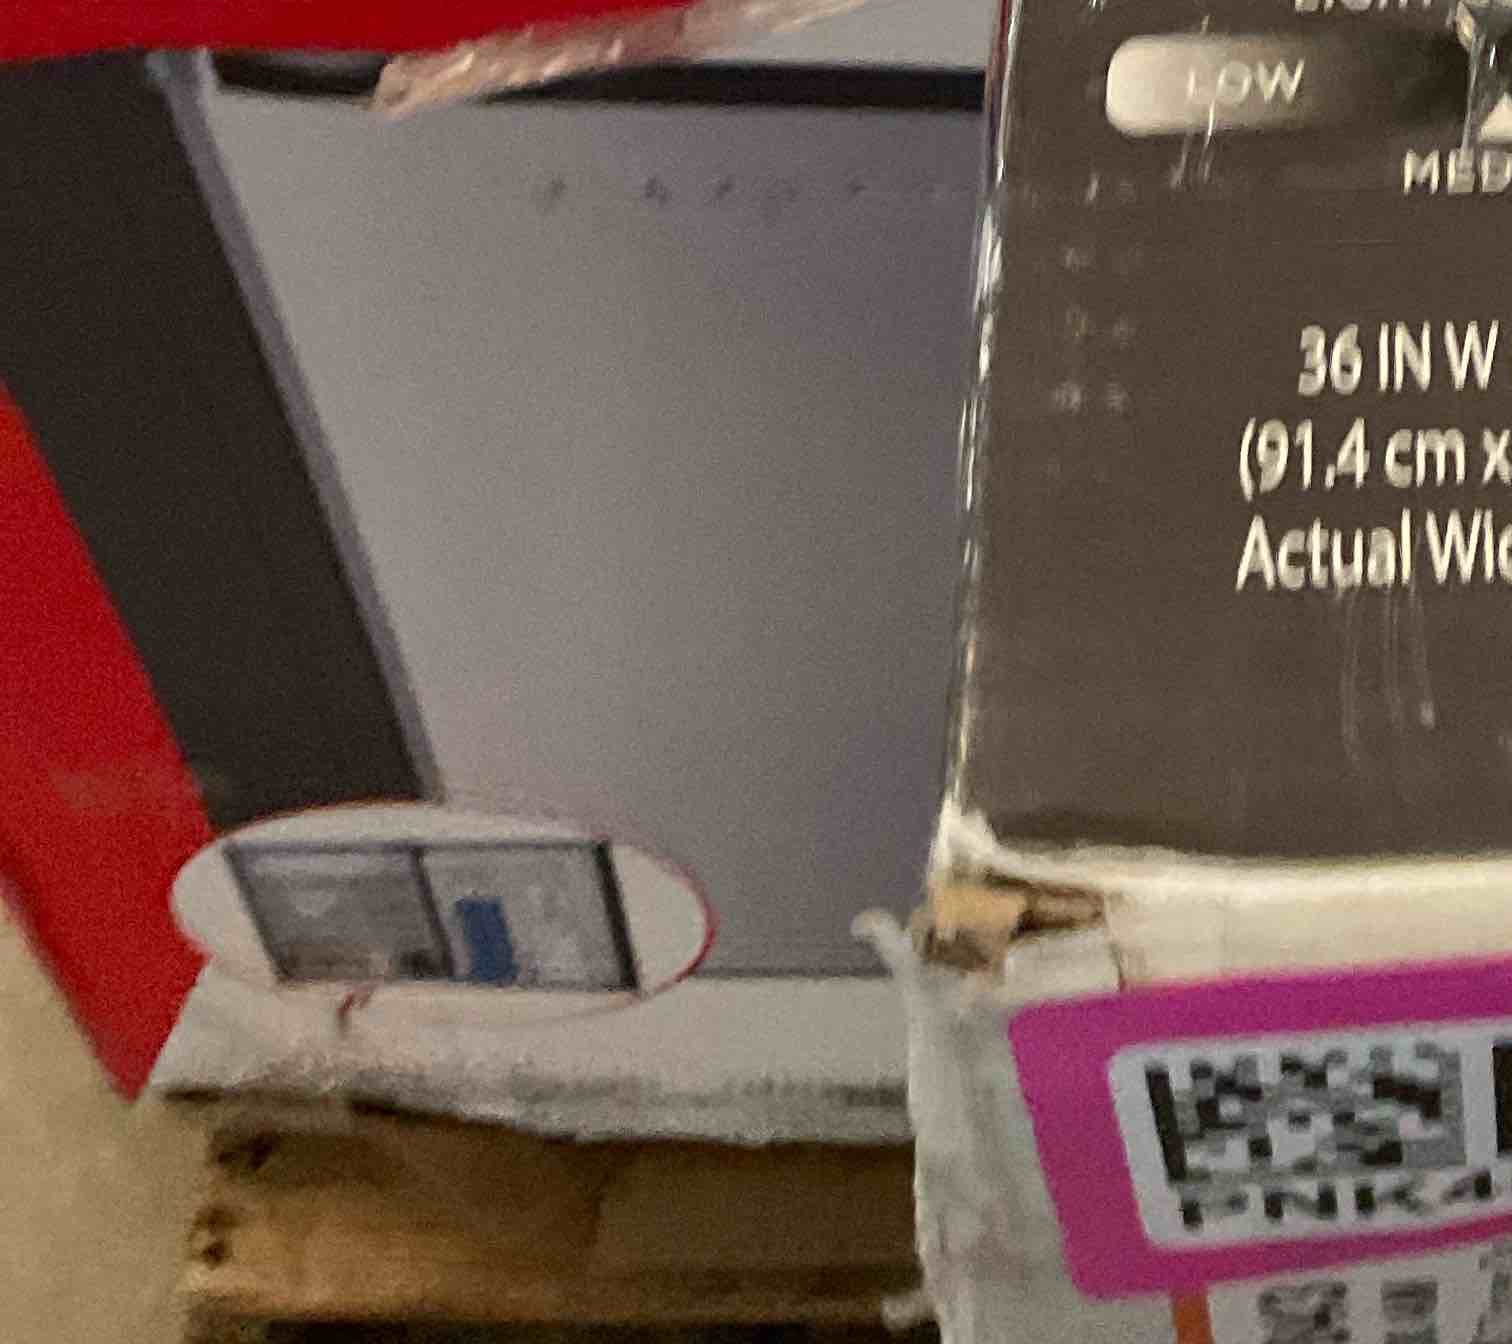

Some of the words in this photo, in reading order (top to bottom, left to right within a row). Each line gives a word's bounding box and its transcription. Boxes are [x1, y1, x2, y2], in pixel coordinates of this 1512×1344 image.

[1186, 59, 1305, 104] LOW
[1298, 324, 1362, 395] 36
[1378, 320, 1432, 392] IN
[1444, 319, 1500, 390] W
[1238, 416, 1371, 502] (91.4
[1384, 427, 1466, 489] cm
[1480, 427, 1512, 487] x
[1235, 507, 1414, 592] Actual
